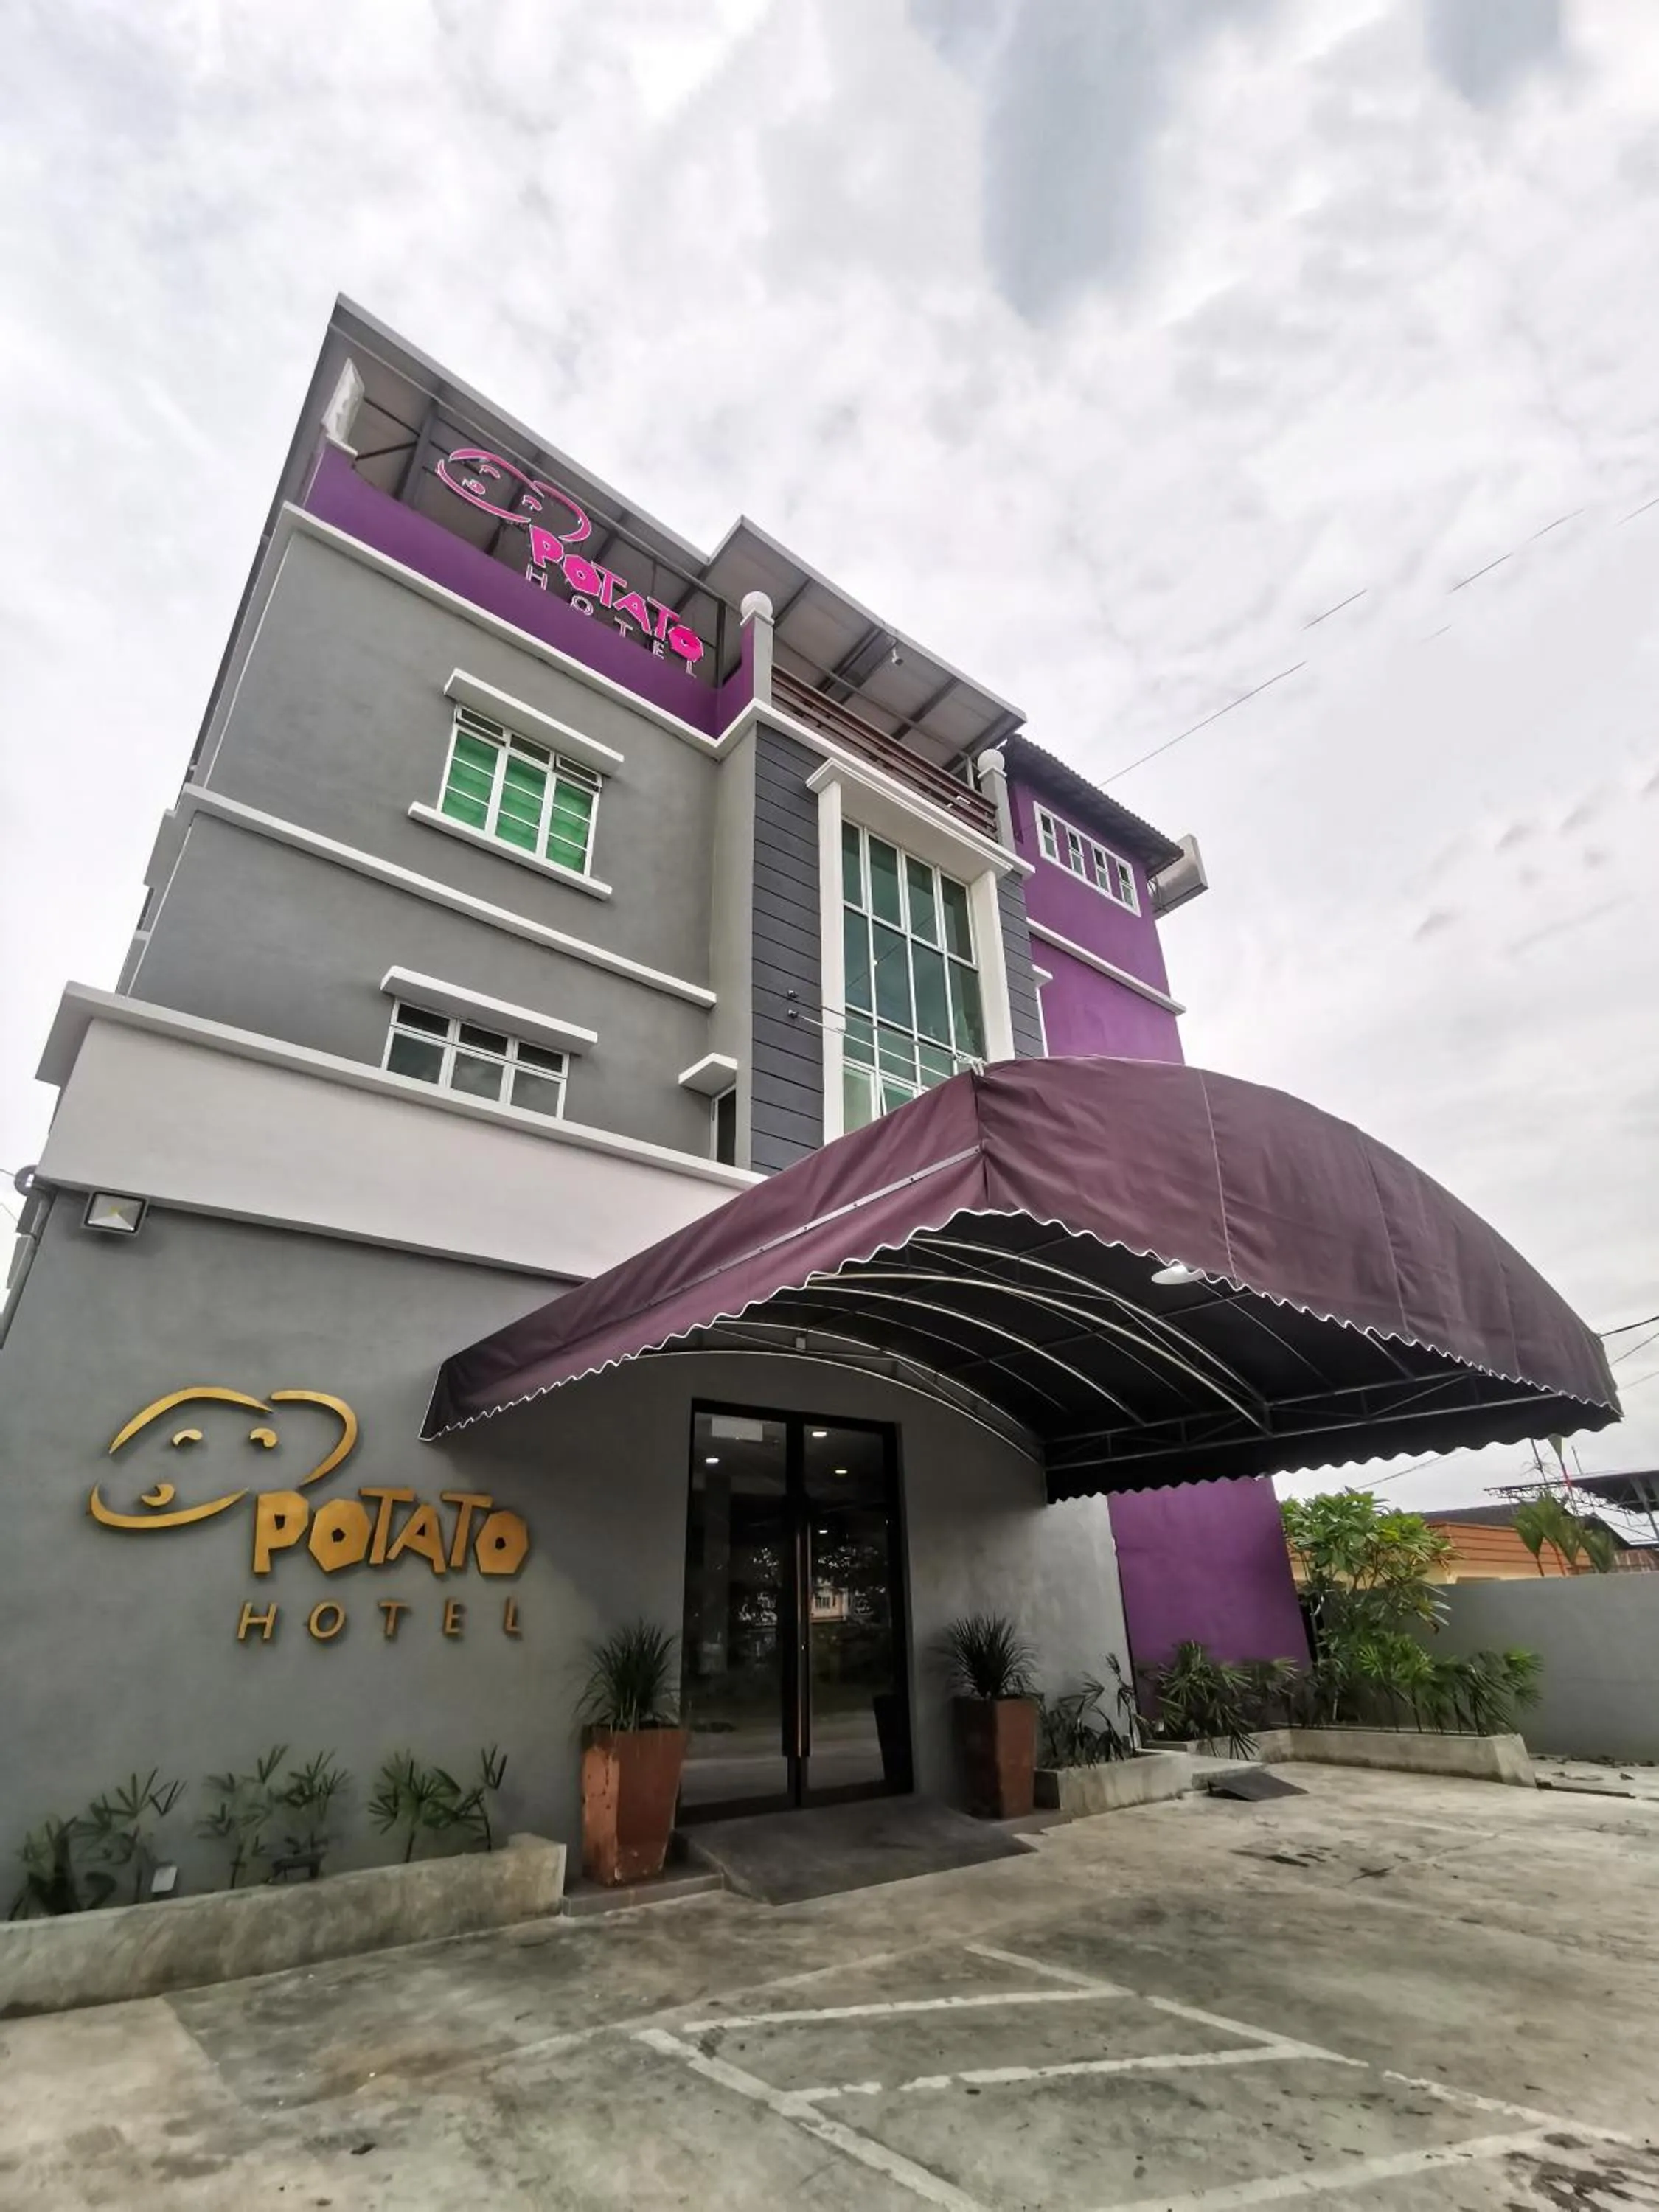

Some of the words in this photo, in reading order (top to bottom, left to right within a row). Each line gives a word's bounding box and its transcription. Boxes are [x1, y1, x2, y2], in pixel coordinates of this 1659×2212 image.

[526, 563, 697, 678] HOTEL
[529, 524, 705, 662] POTATO
[252, 1486, 529, 1575] POTATO
[237, 1595, 523, 1641] HOTEL
